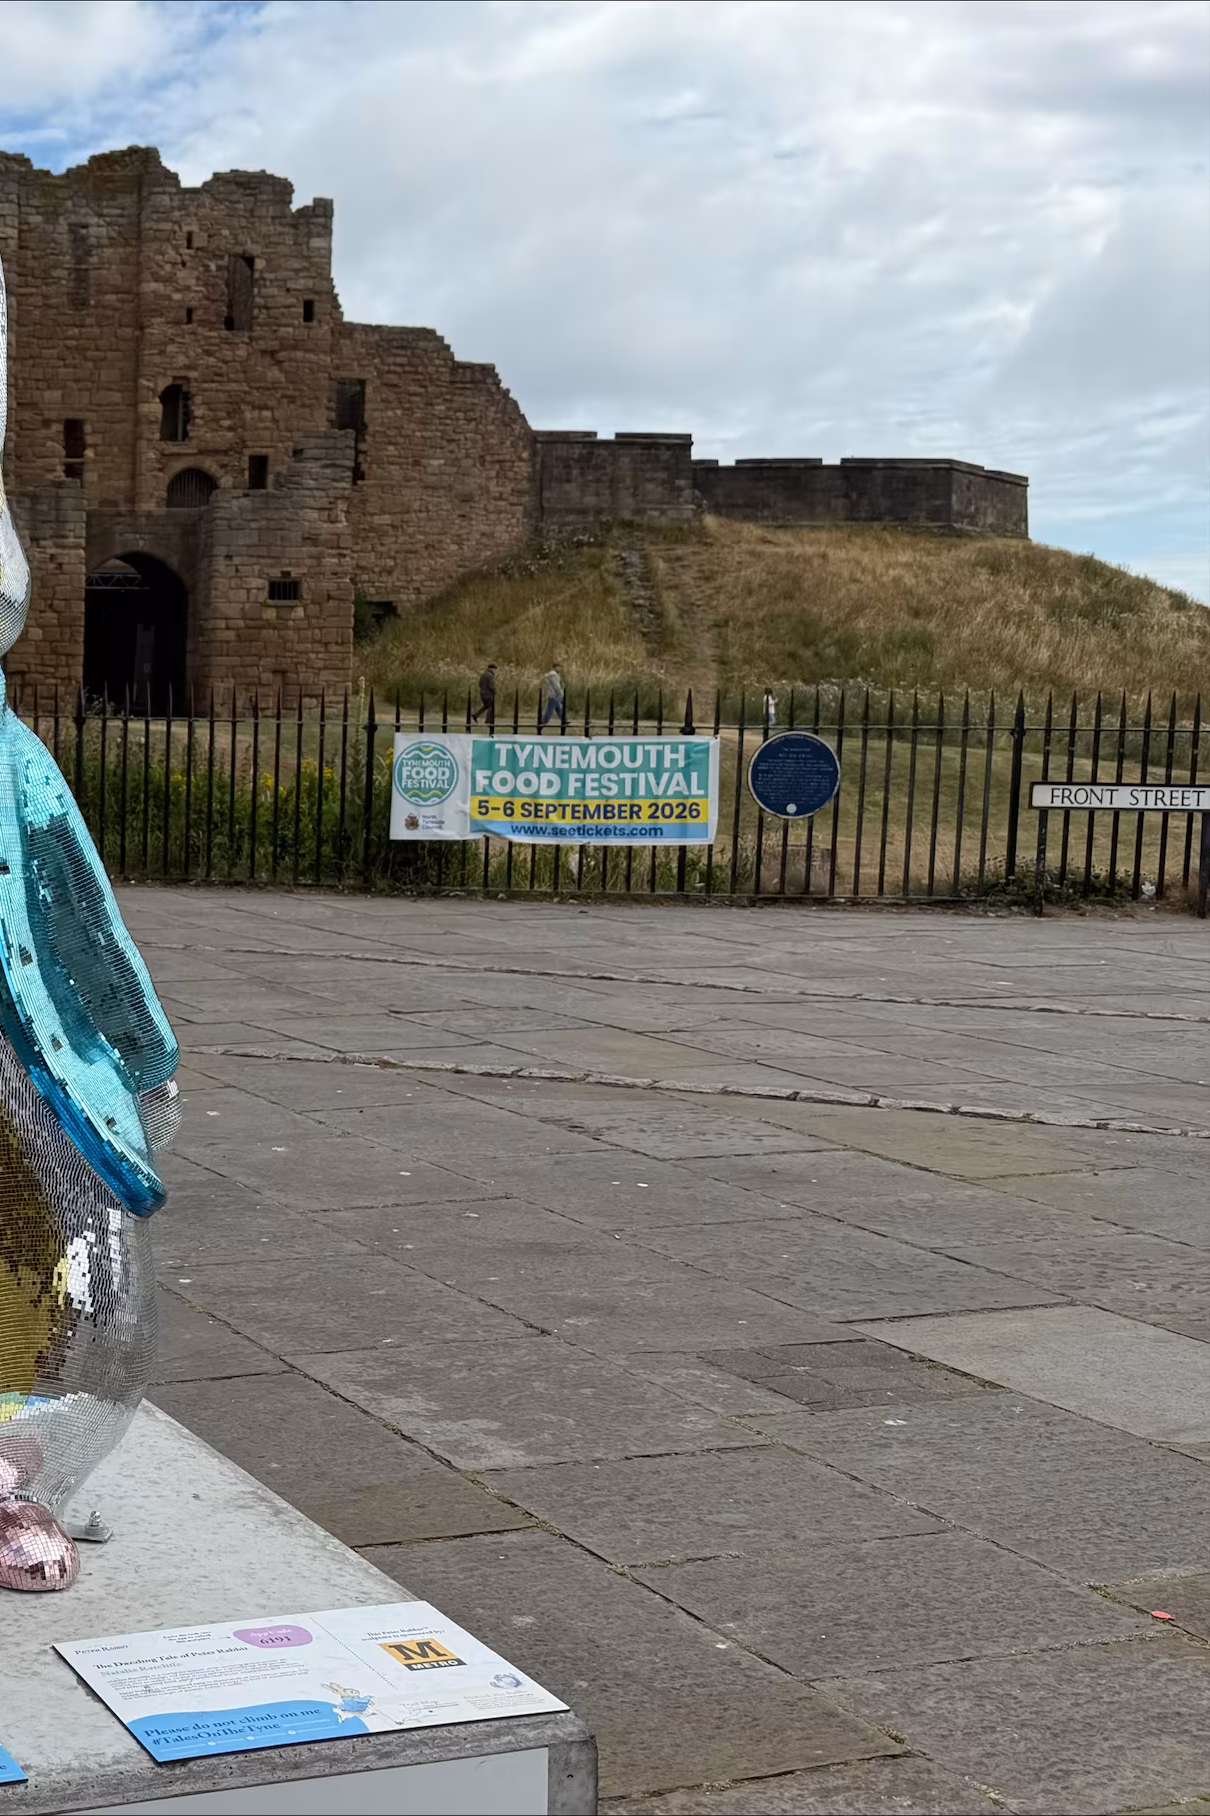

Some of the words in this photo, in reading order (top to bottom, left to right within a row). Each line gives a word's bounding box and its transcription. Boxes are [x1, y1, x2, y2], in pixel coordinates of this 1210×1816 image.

[495, 743, 685, 769] TYNEMOUTH
[402, 767, 450, 780] FOOD
[475, 769, 561, 794] FOOD
[568, 772, 705, 796] FESTIVAL
[402, 779, 449, 788] FESTIVAL
[1050, 787, 1119, 805] FRONT
[1129, 788, 1206, 807] STREET
[521, 802, 642, 820] SEPTEMBER
[647, 802, 701, 819] 2026
[511, 824, 663, 837] www.seetickets.com
[260, 1636, 291, 1644] 6191
[388, 1641, 448, 1661] M
[113, 1658, 158, 1667] Dazzling
[411, 1659, 459, 1670] METRO
[144, 1727, 188, 1737] Please
[239, 1714, 277, 1723] climb
[153, 1724, 280, 1745] #TalesOnTheTyne
